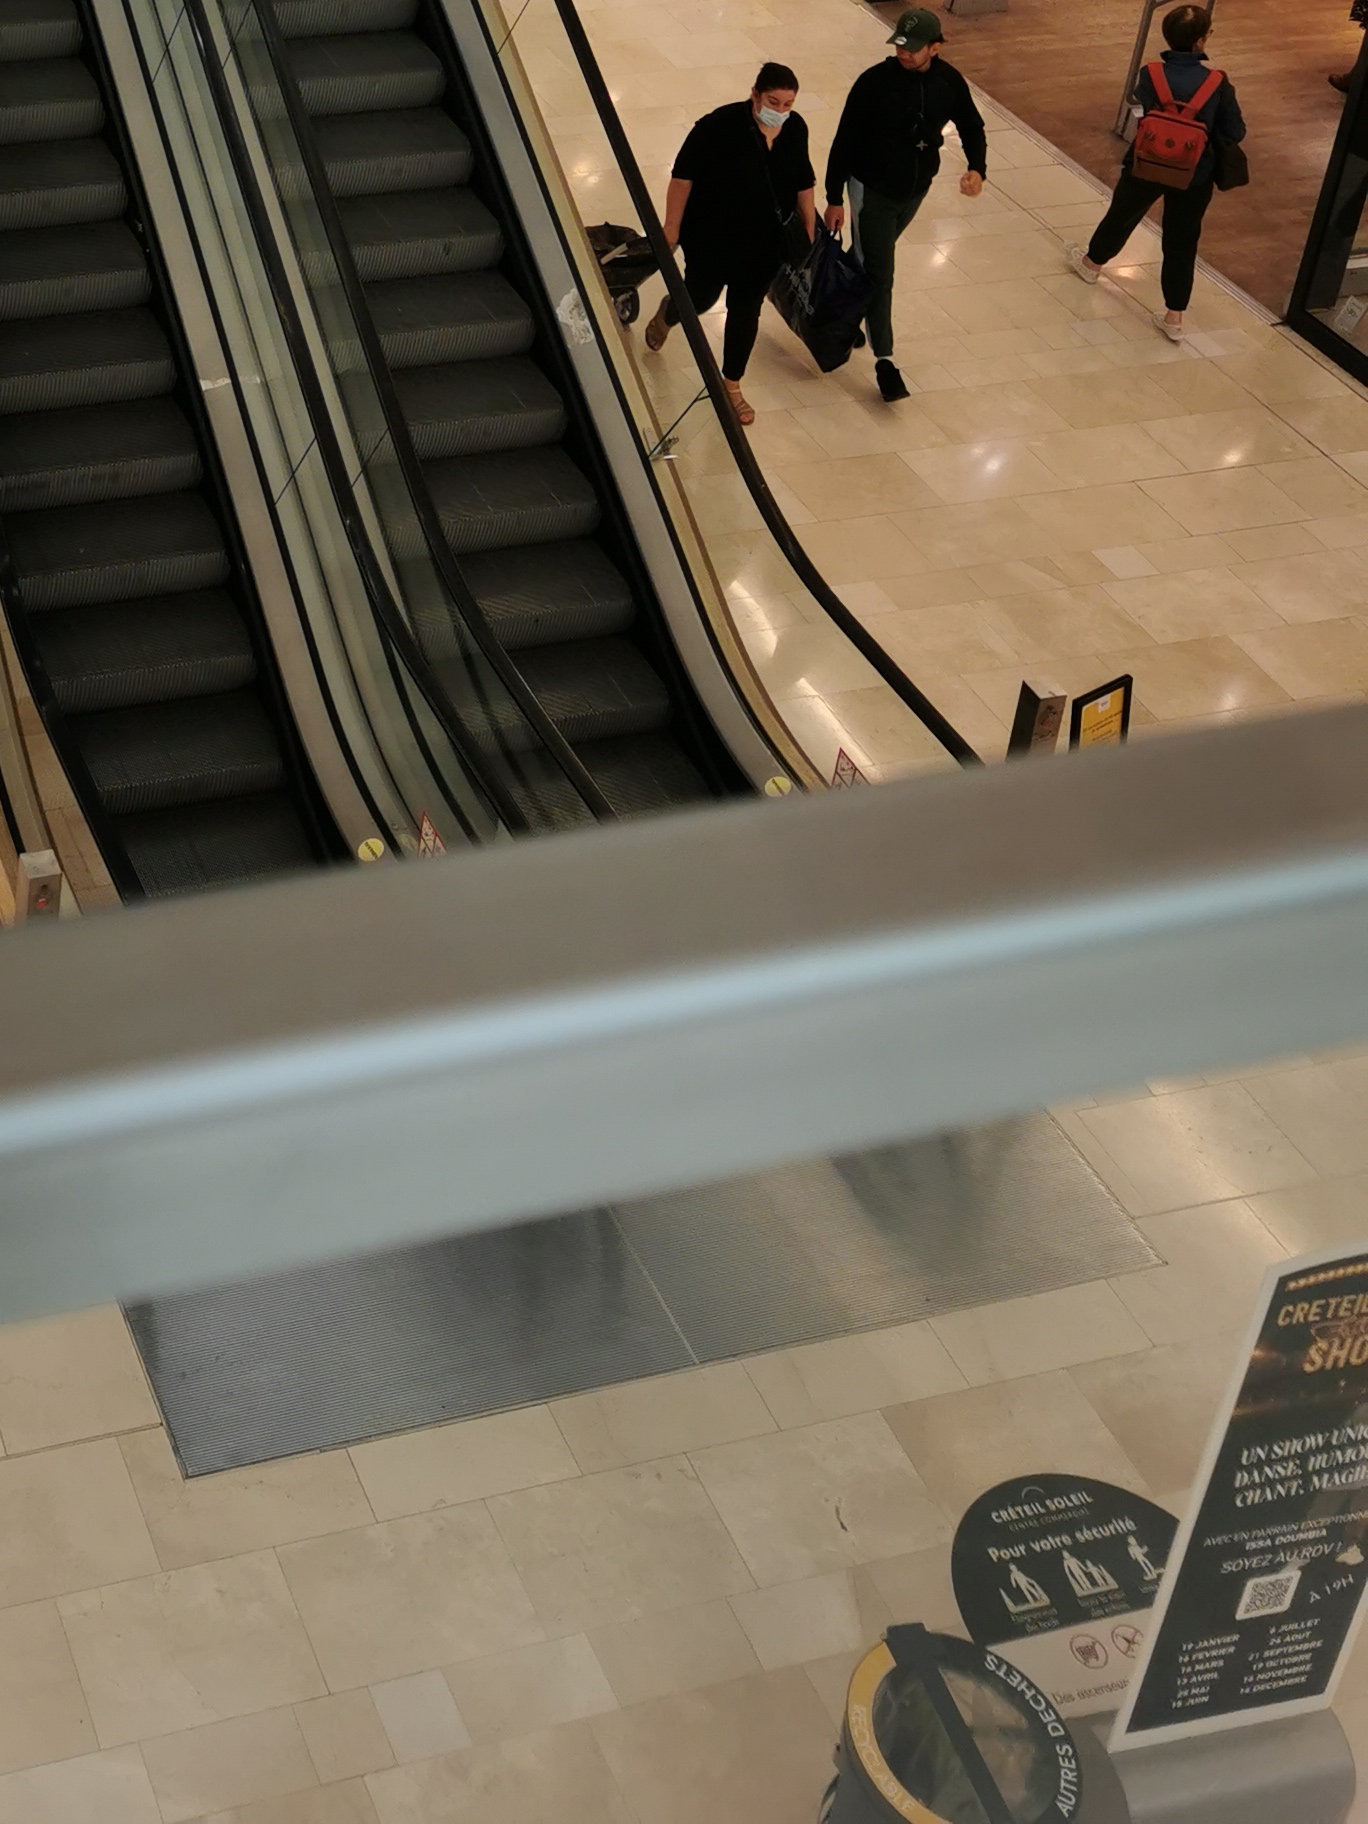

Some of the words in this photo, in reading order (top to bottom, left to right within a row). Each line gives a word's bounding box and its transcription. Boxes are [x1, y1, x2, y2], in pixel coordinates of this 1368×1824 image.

[1240, 1444, 1269, 1466] UN
[1270, 1431, 1329, 1460] SHOW
[990, 1500, 1046, 1524] CRÉTEIL
[1045, 1490, 1094, 1512] SOLEIL
[987, 1543, 1027, 1563] Pour
[1029, 1533, 1073, 1553] votre
[1074, 1516, 1137, 1543] sécurité
[1220, 1553, 1274, 1575] SOYEZ
[1195, 1634, 1240, 1650] JANVIER
[1194, 1659, 1225, 1672] MARS
[984, 1652, 1066, 1739] DECHETS
[1054, 1743, 1078, 1819] AUTRES
